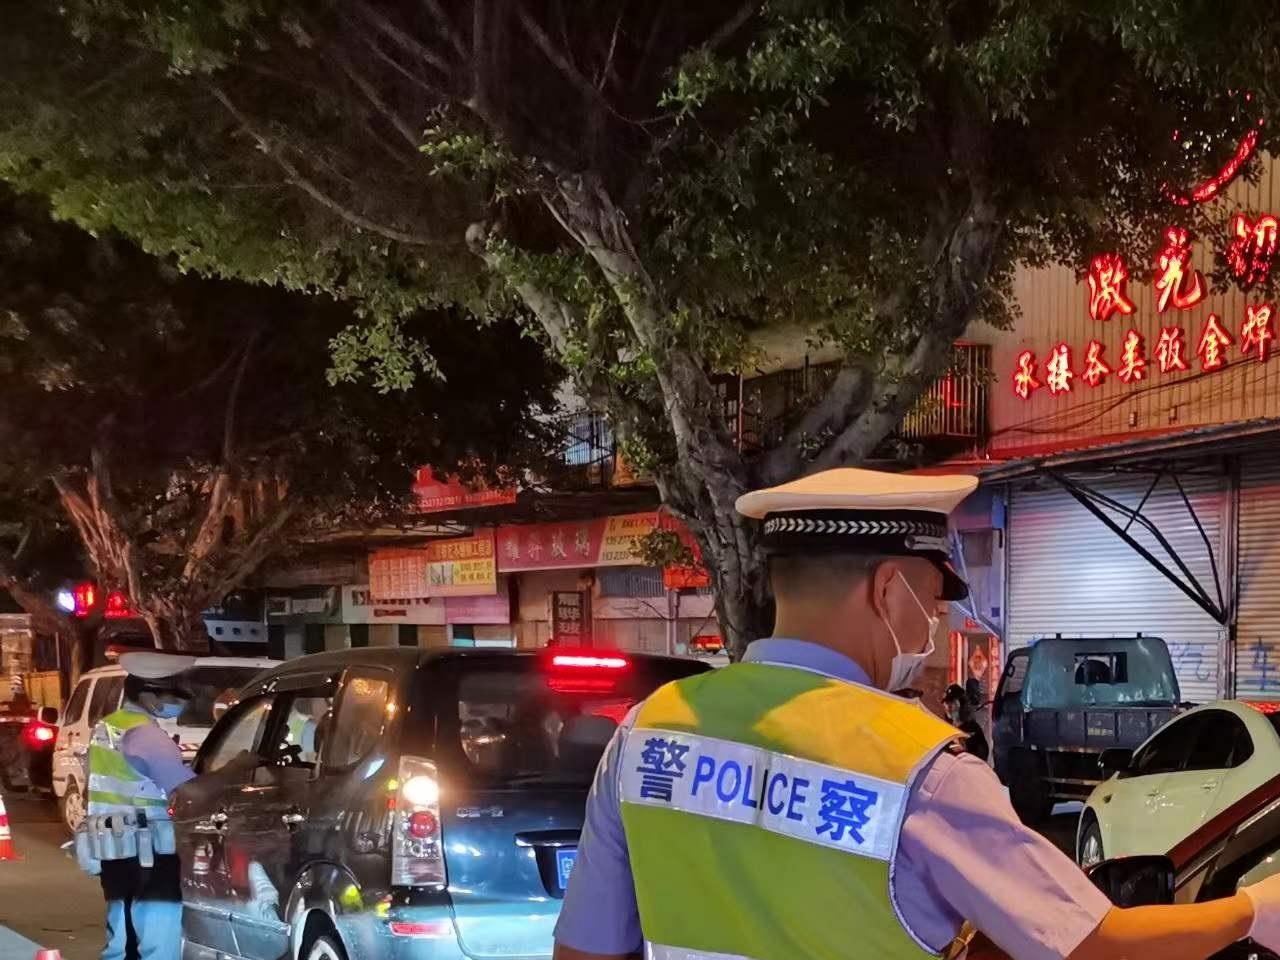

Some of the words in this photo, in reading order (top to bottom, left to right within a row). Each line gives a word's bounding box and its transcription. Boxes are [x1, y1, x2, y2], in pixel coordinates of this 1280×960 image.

[635, 736, 691, 802] 警
[690, 754, 810, 822] POLICE
[815, 778, 879, 846] 察
